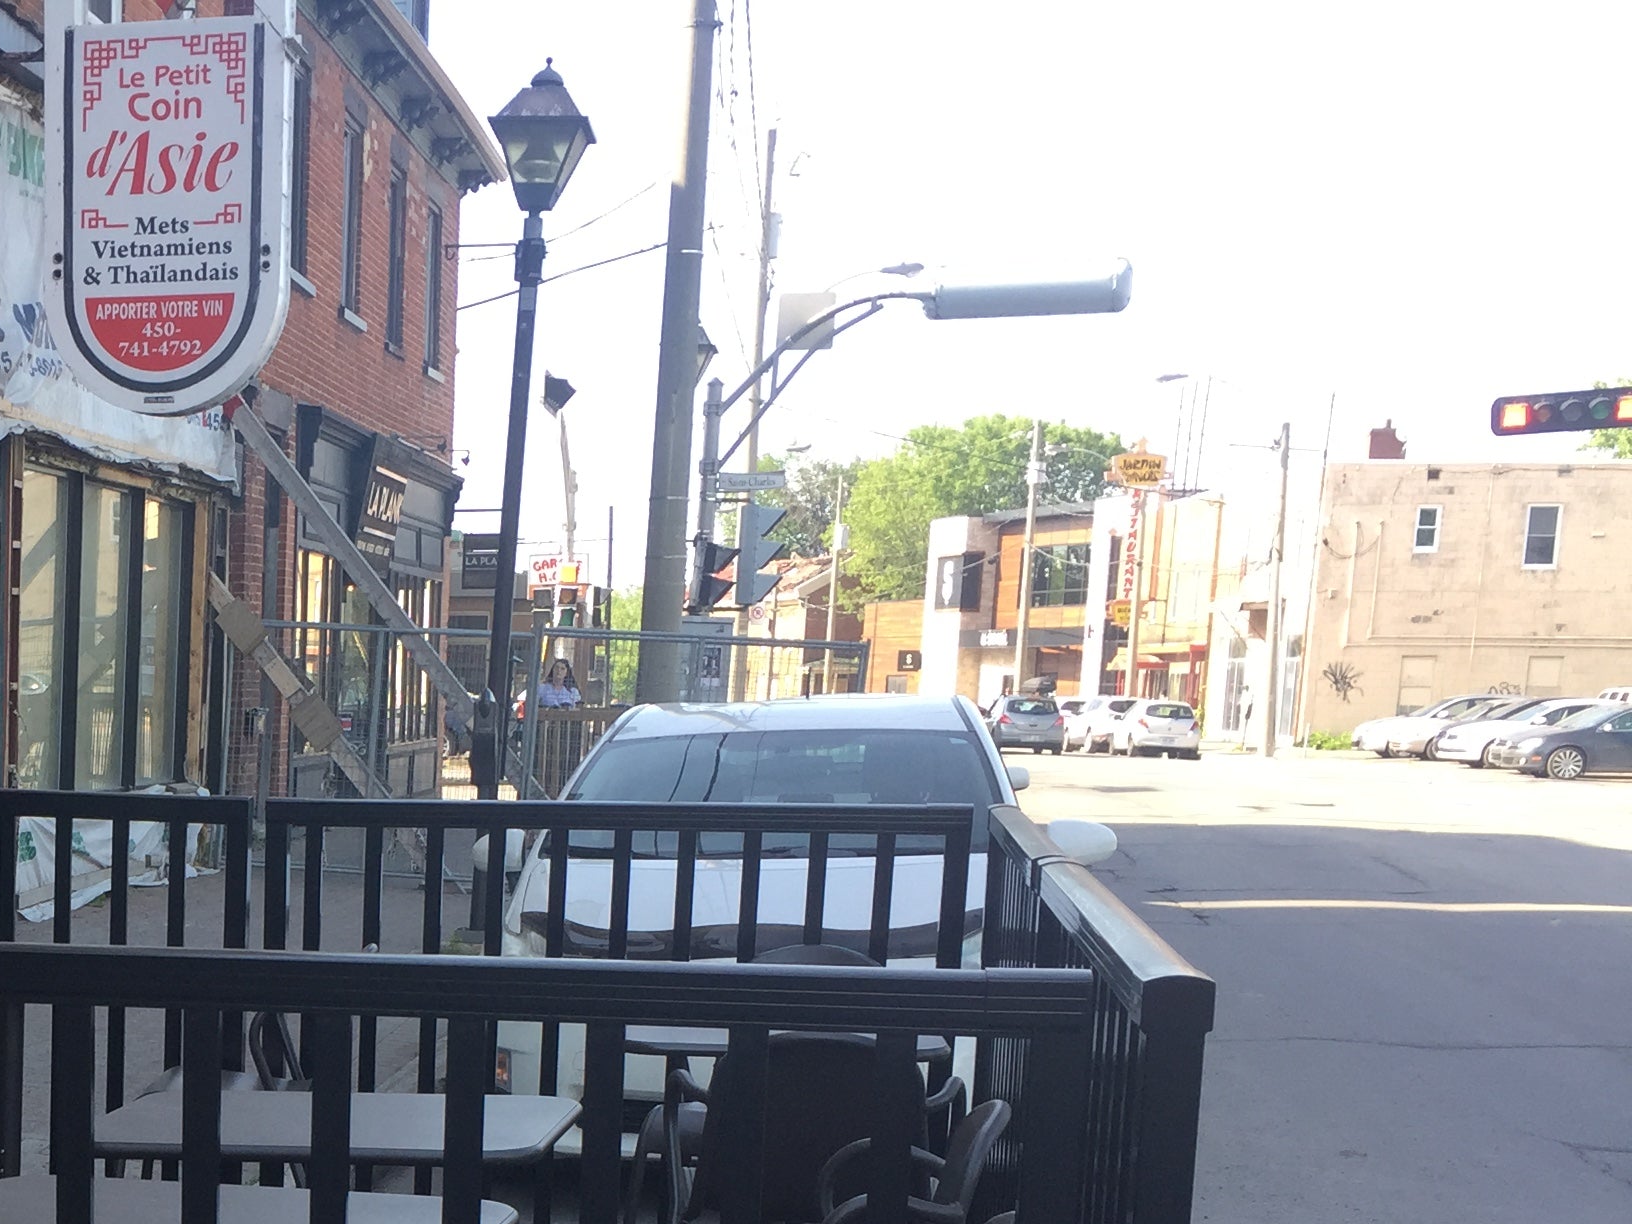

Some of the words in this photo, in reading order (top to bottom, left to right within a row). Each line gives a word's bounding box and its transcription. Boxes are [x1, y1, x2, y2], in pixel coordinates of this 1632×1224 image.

[119, 66, 146, 88] Le
[155, 63, 212, 87] Petit
[128, 89, 202, 122] Coin
[86, 130, 240, 196] d'Asie
[134, 216, 190, 236] Mets
[91, 237, 233, 259] Vietnamiens
[82, 266, 102, 286] &
[108, 261, 239, 284] Thaïlandais
[95, 301, 157, 320] APPORTER
[160, 300, 198, 318] VOTRE
[202, 299, 224, 317] VIN
[141, 321, 181, 338] 450-
[118, 340, 202, 357] 741-4792
[464, 556, 478, 566] LA
